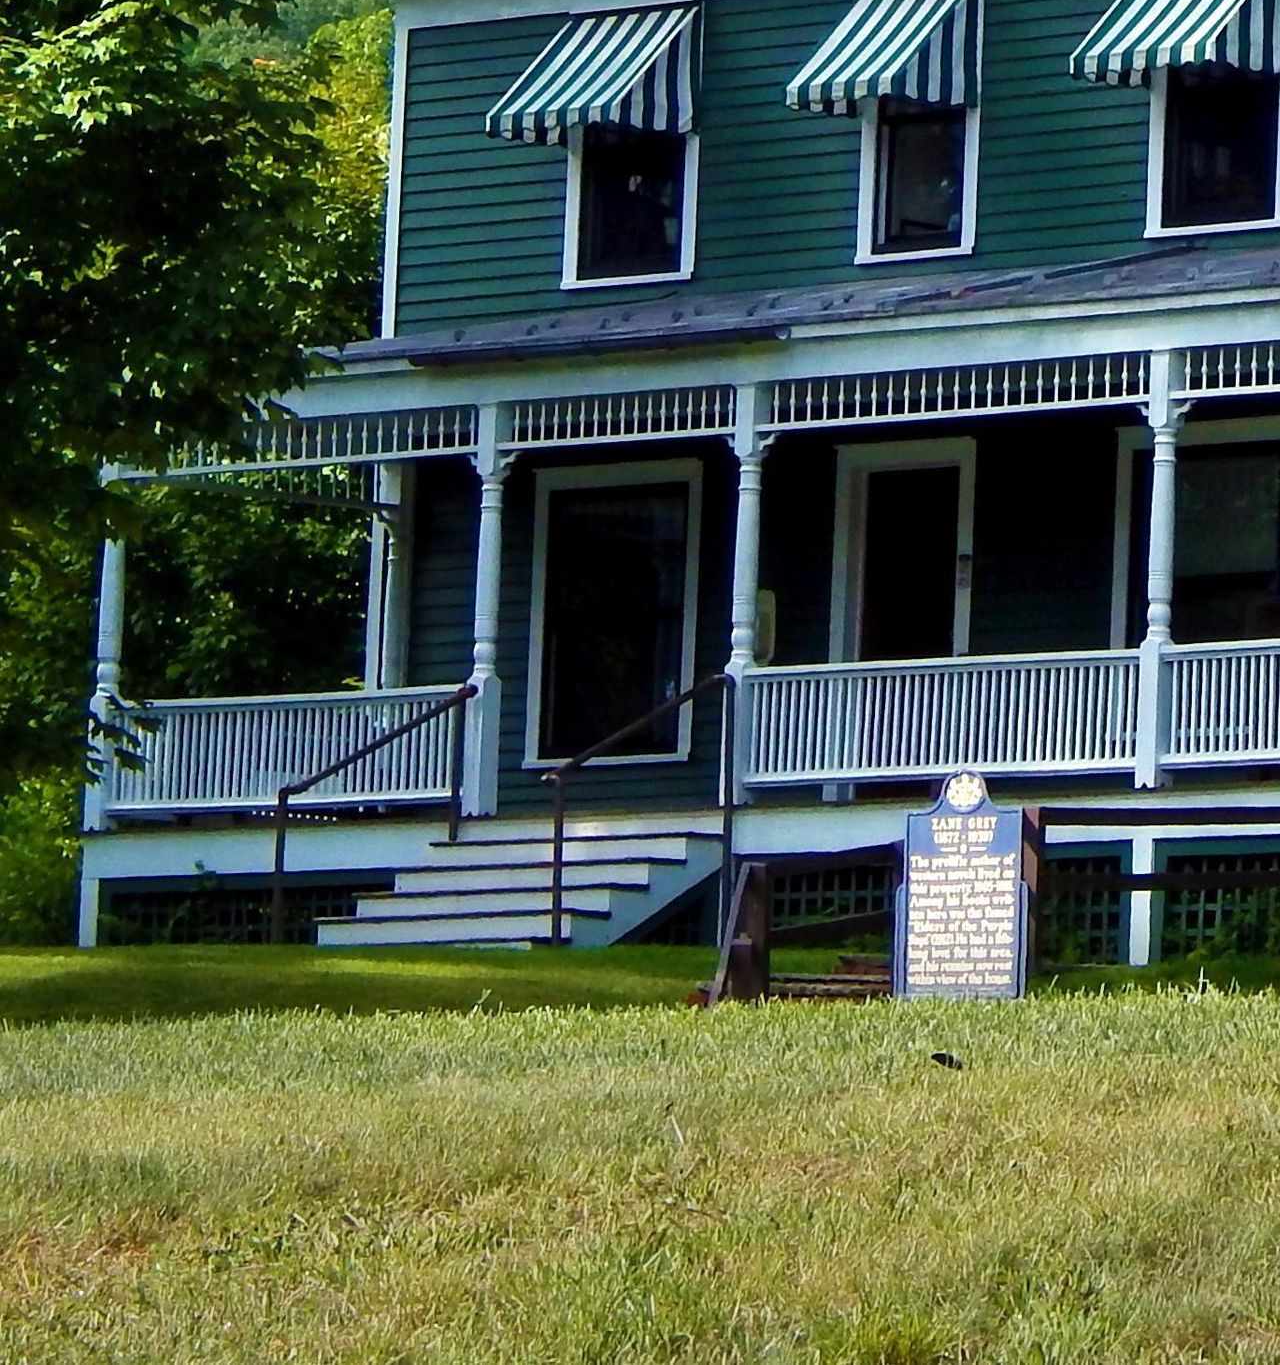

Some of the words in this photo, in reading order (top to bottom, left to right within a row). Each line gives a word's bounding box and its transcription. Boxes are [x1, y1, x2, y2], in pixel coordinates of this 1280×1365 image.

[931, 817, 963, 831] ZANE
[967, 816, 998, 830] GREY
[909, 855, 929, 868] The
[1002, 853, 1016, 866] of
[977, 867, 1001, 880] lived
[909, 894, 944, 909] Among
[948, 920, 960, 931] of
[961, 920, 978, 931] the
[980, 919, 1013, 934] Purple
[931, 946, 951, 958] love
[953, 946, 968, 958] for
[969, 946, 988, 958] this
